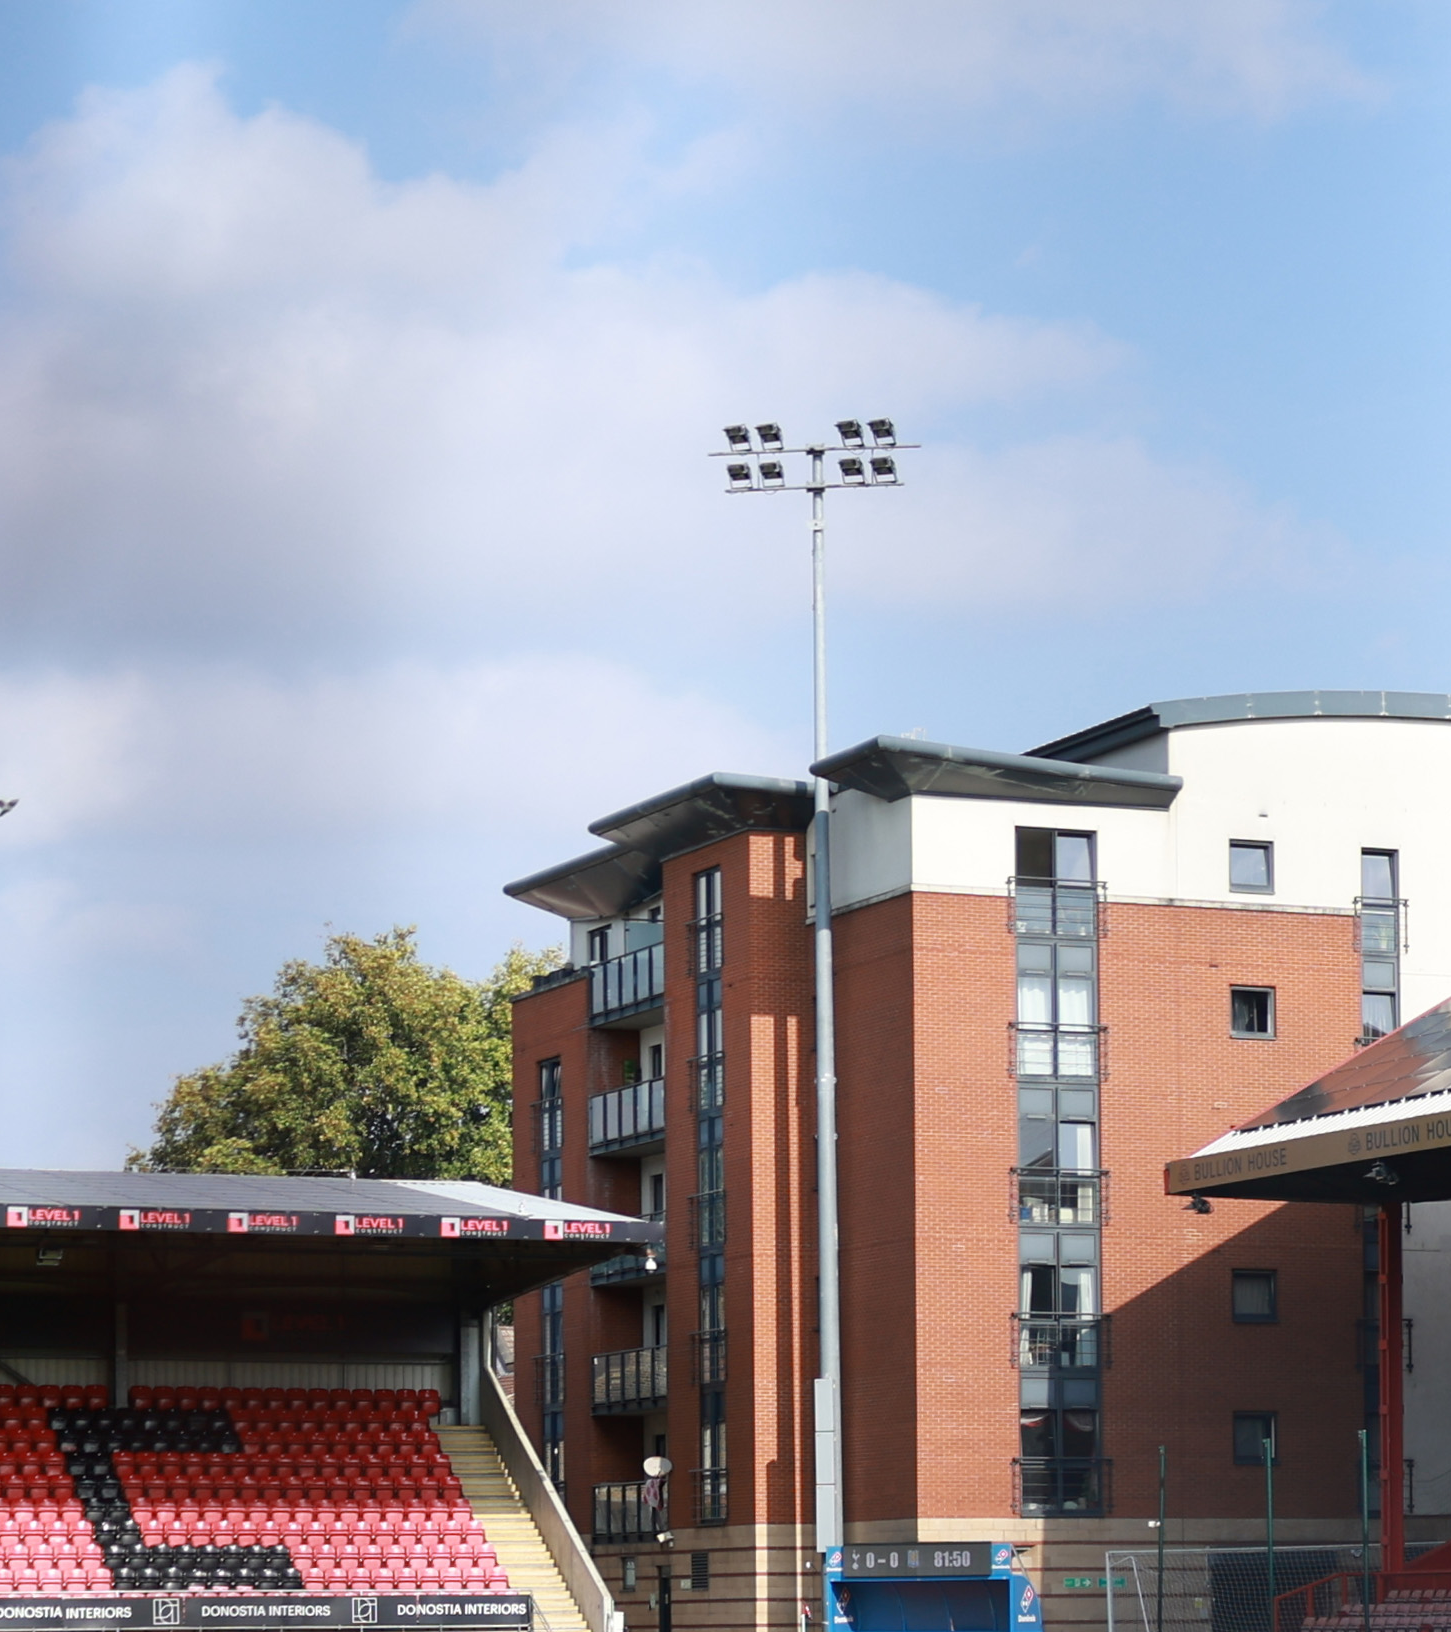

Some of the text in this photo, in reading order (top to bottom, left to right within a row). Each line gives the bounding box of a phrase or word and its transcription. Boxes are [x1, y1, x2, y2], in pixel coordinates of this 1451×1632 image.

[1366, 1125, 1419, 1150] BULLION
[1194, 1148, 1287, 1180] BULLION HOUSE
[29, 1209, 80, 1221] LEVEL 1
[140, 1212, 191, 1224] LEVEL 1
[249, 1215, 298, 1227] LEVEL 1
[355, 1217, 404, 1229] LEVEL 1
[461, 1220, 509, 1231] LEVEL 1
[564, 1223, 611, 1234] LEVEL 1
[866, 1552, 875, 1568] 0
[889, 1552, 899, 1568] 0
[934, 1551, 970, 1568] 81:50
[65, 1607, 132, 1619] INTERIORS
[201, 1605, 331, 1617] DONOSTIA INTERIORS
[397, 1603, 527, 1616] DONOSTIA INTERIORS
